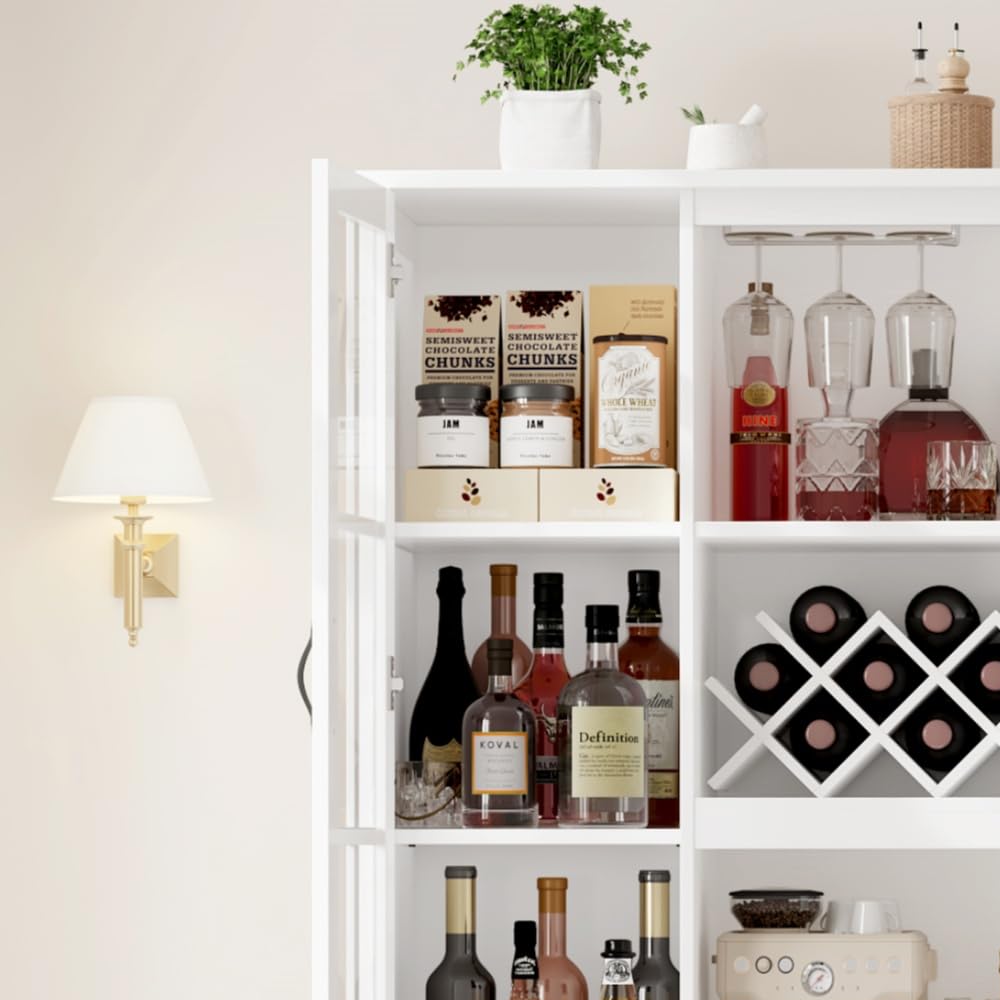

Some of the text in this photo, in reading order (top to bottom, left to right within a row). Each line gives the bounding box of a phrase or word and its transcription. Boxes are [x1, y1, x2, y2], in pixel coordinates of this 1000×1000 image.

[425, 336, 496, 345] SEMISWEET
[508, 333, 578, 341] SEMISWEET
[425, 346, 496, 354] CHOCOLATE
[507, 343, 578, 351] CHOCOLATE
[425, 357, 496, 369] CHUNKS
[507, 353, 578, 366] CHUNKS
[443, 419, 460, 429] JAM
[526, 419, 544, 429] JAM
[579, 730, 639, 743] Definition
[479, 740, 519, 749] KOVAL
